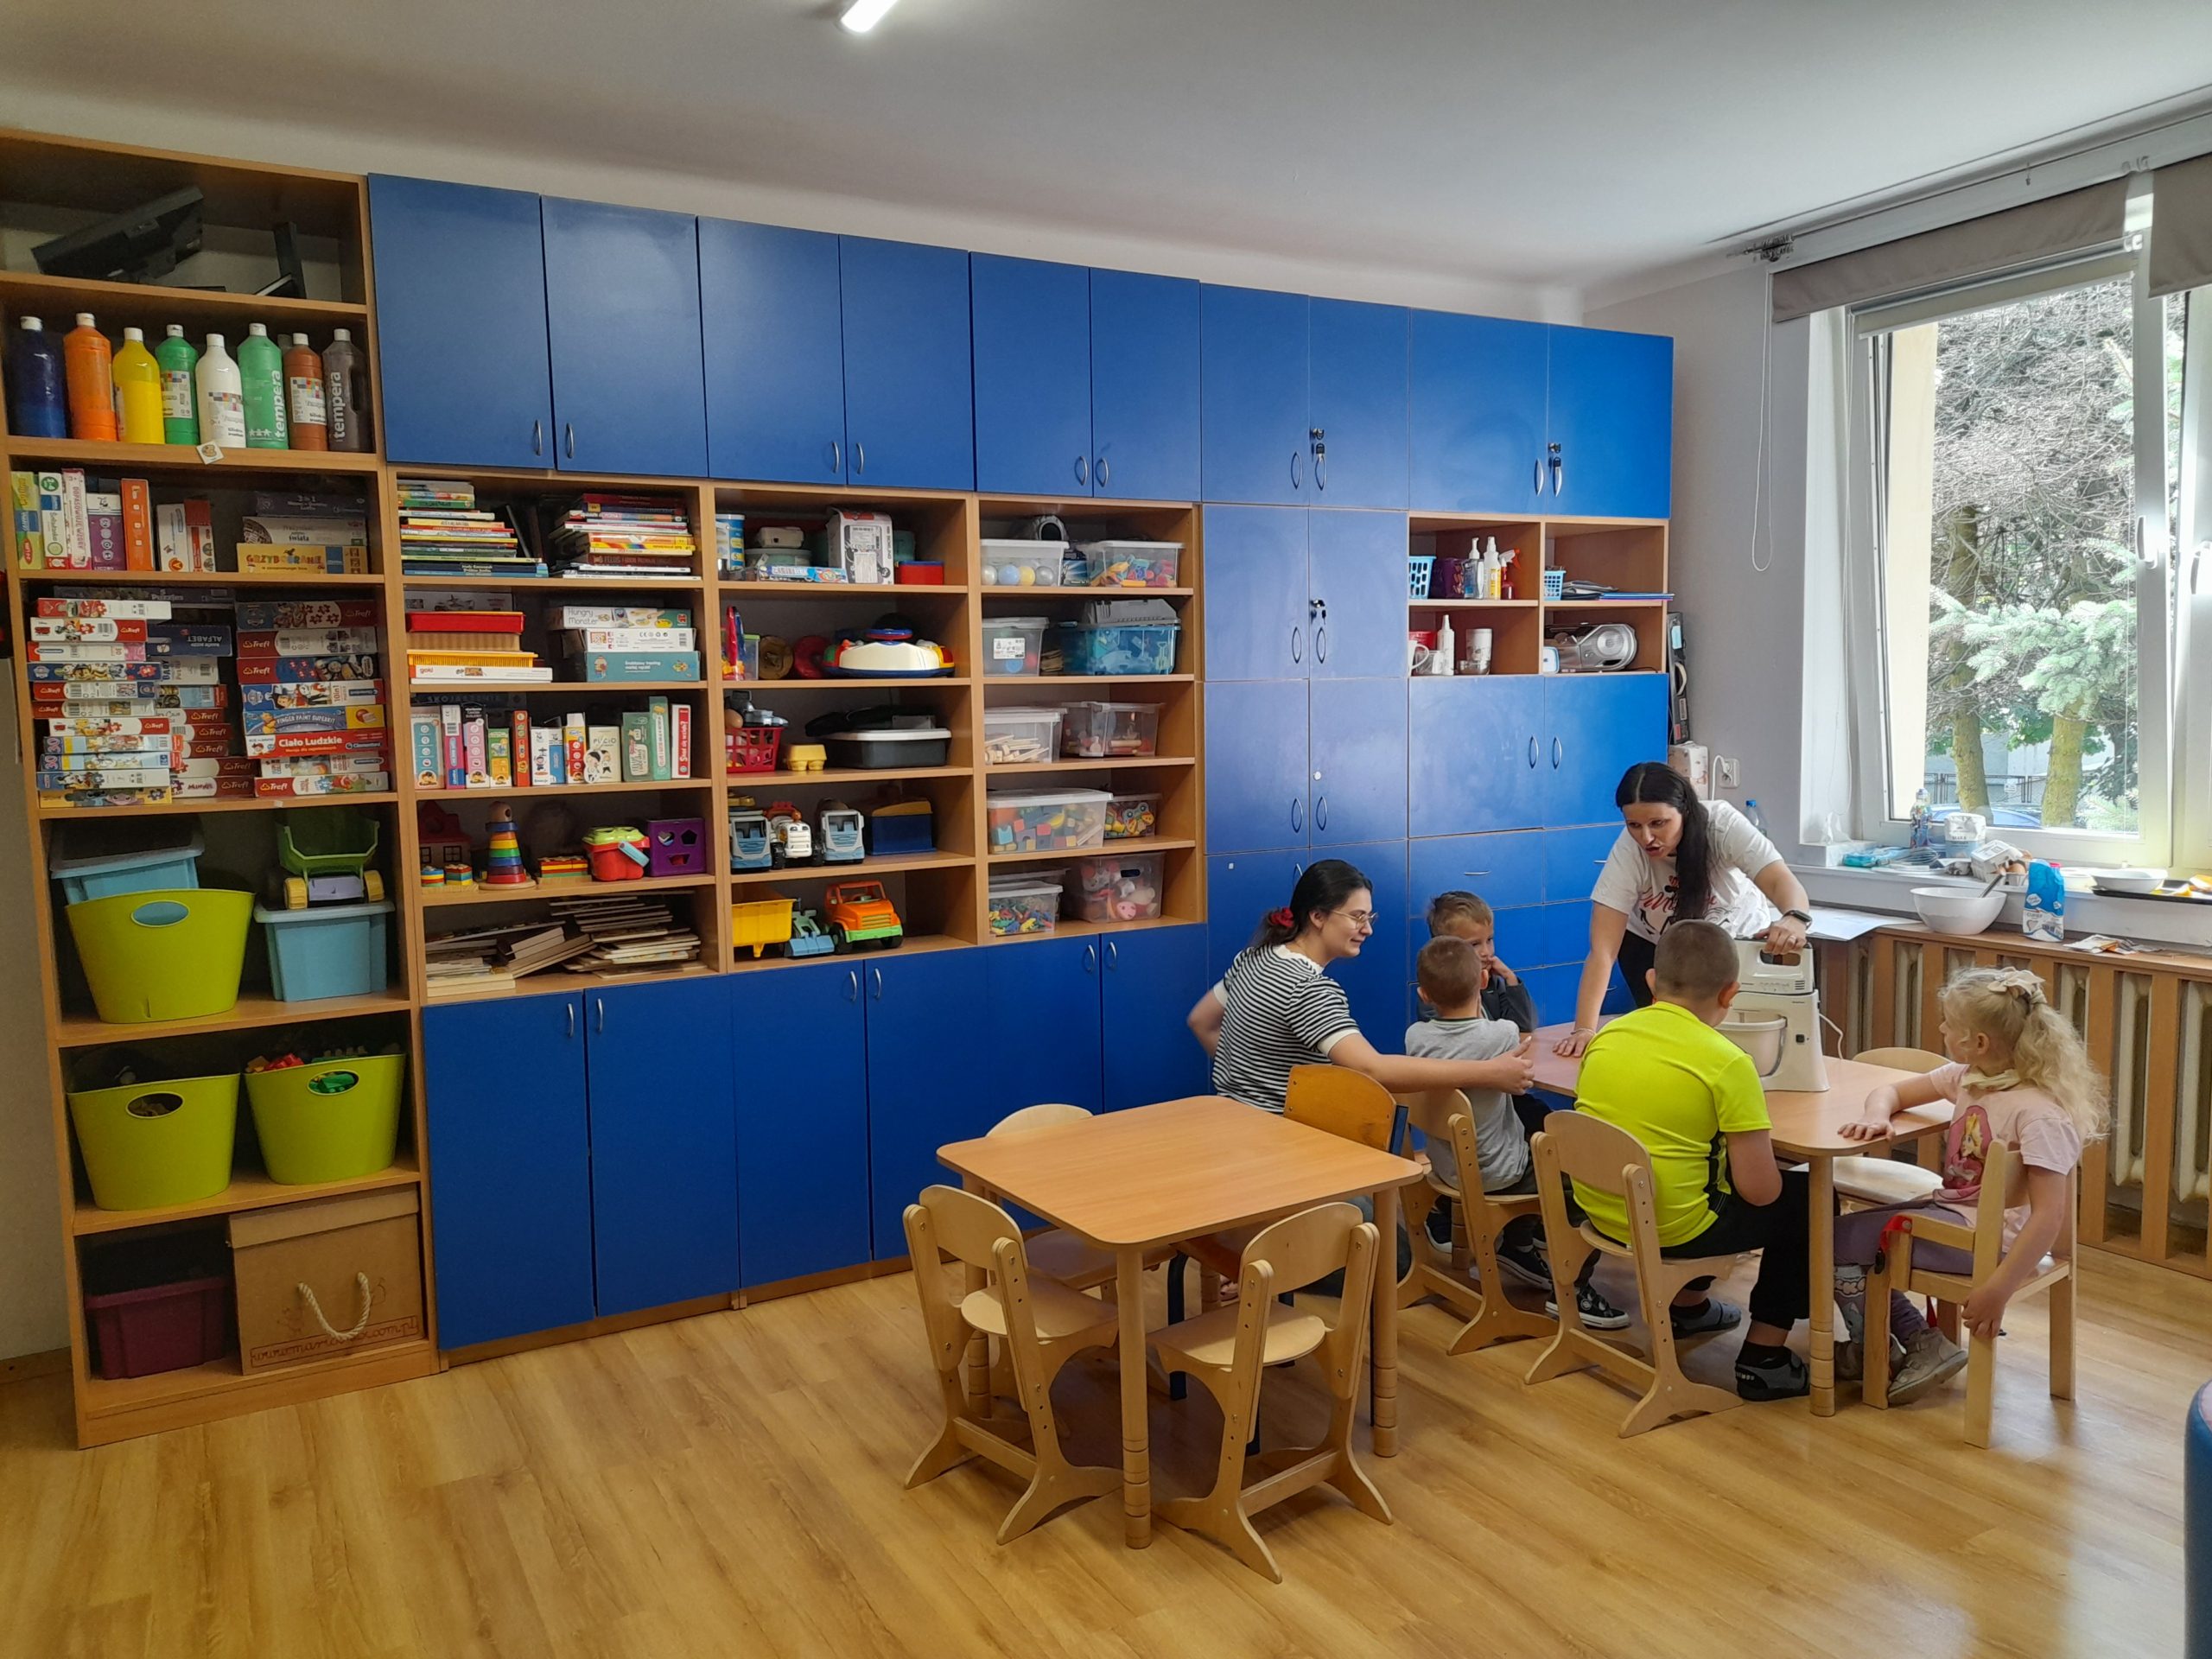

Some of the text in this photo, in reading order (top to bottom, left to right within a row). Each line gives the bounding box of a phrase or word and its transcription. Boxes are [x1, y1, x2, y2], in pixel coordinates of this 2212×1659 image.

[272, 370, 285, 438] tempera
[331, 372, 346, 439] tempera
[568, 607, 594, 617] Hungry
[252, 639, 270, 648] Trefl
[252, 666, 270, 675] Trefl
[48, 737, 61, 754] 30
[278, 736, 343, 747] Ciało Ludzkie
[45, 755, 58, 771] 30
[270, 782, 289, 791] Trefl
